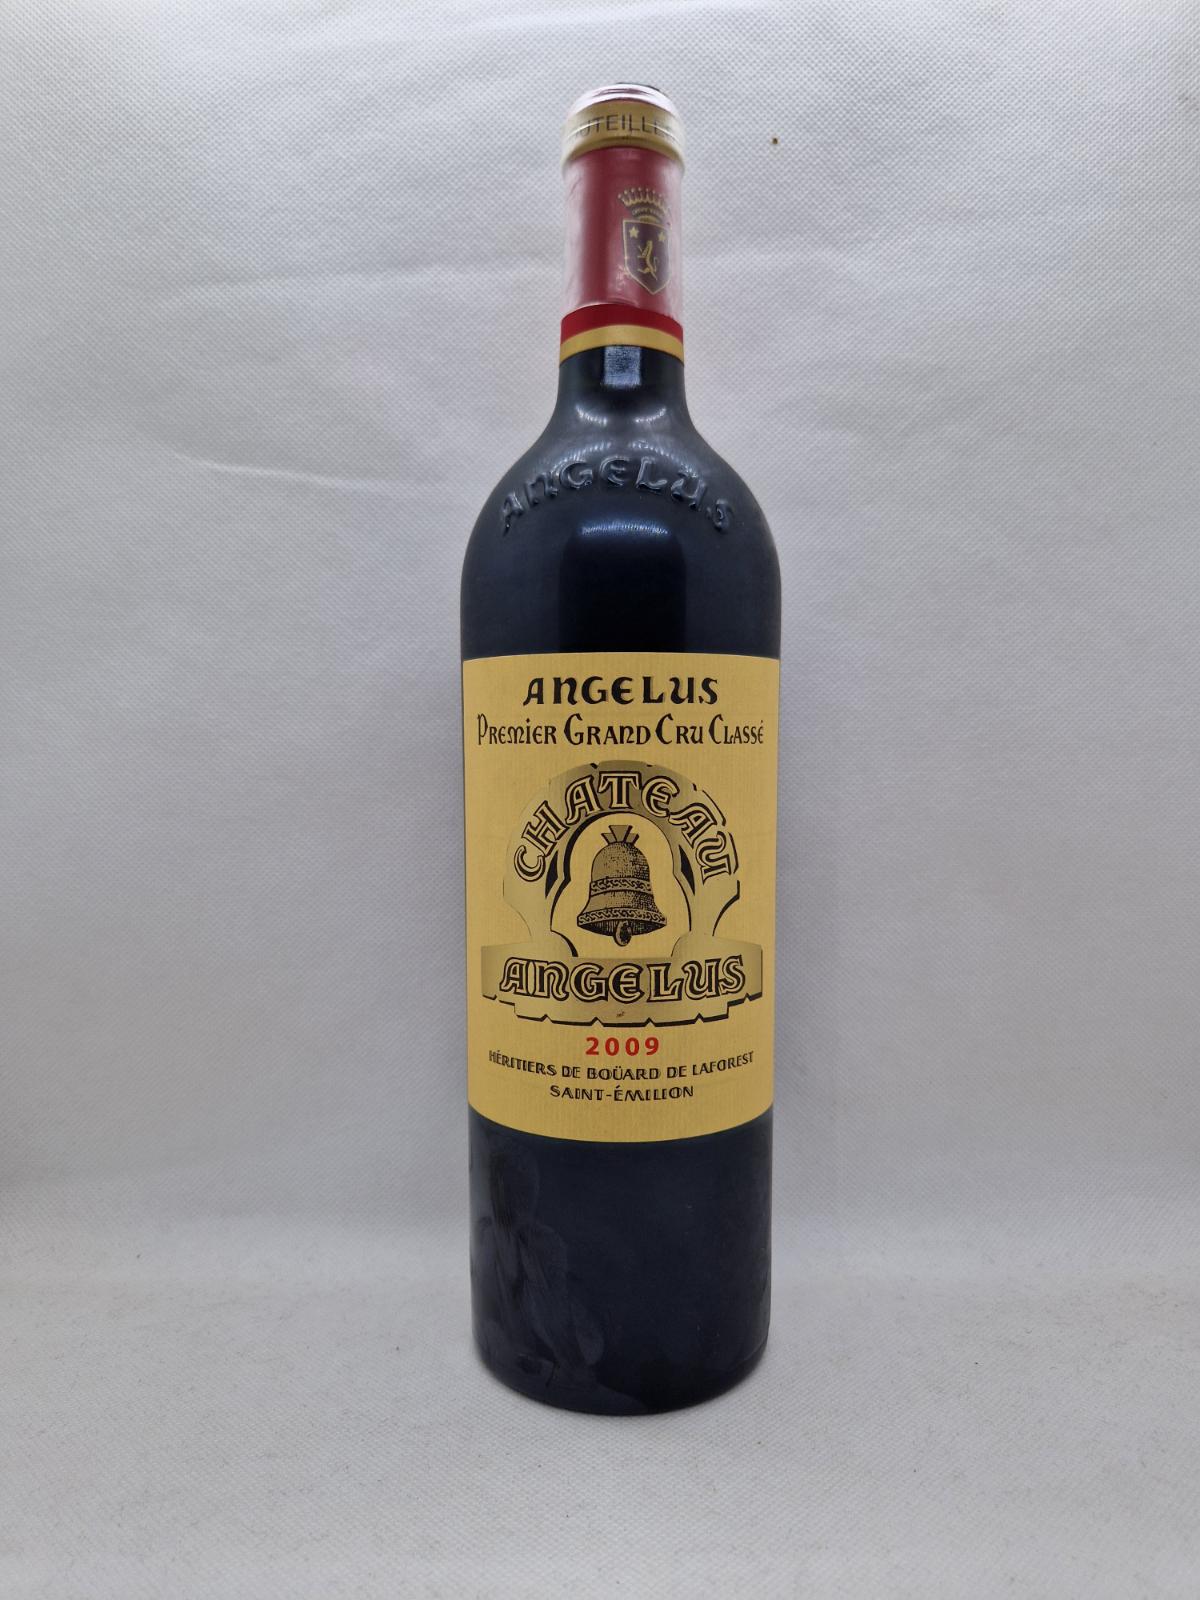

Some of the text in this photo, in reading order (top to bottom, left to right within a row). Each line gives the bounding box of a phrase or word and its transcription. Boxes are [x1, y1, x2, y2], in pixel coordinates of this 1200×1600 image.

[502, 456, 734, 536] ANGELUS
[523, 676, 718, 706] ANGELUS
[563, 713, 651, 745] GRAND
[655, 713, 703, 745] CRU
[708, 713, 764, 745] CLASSÉ
[513, 770, 738, 885] CHATEAU
[499, 955, 745, 1005] ANGELUS
[585, 1036, 660, 1057] 2009
[488, 1049, 754, 1080] HÉRITIERS DE BOÜARD DE LAFOREST
[550, 1084, 694, 1102] SAINT-ÉMILION
